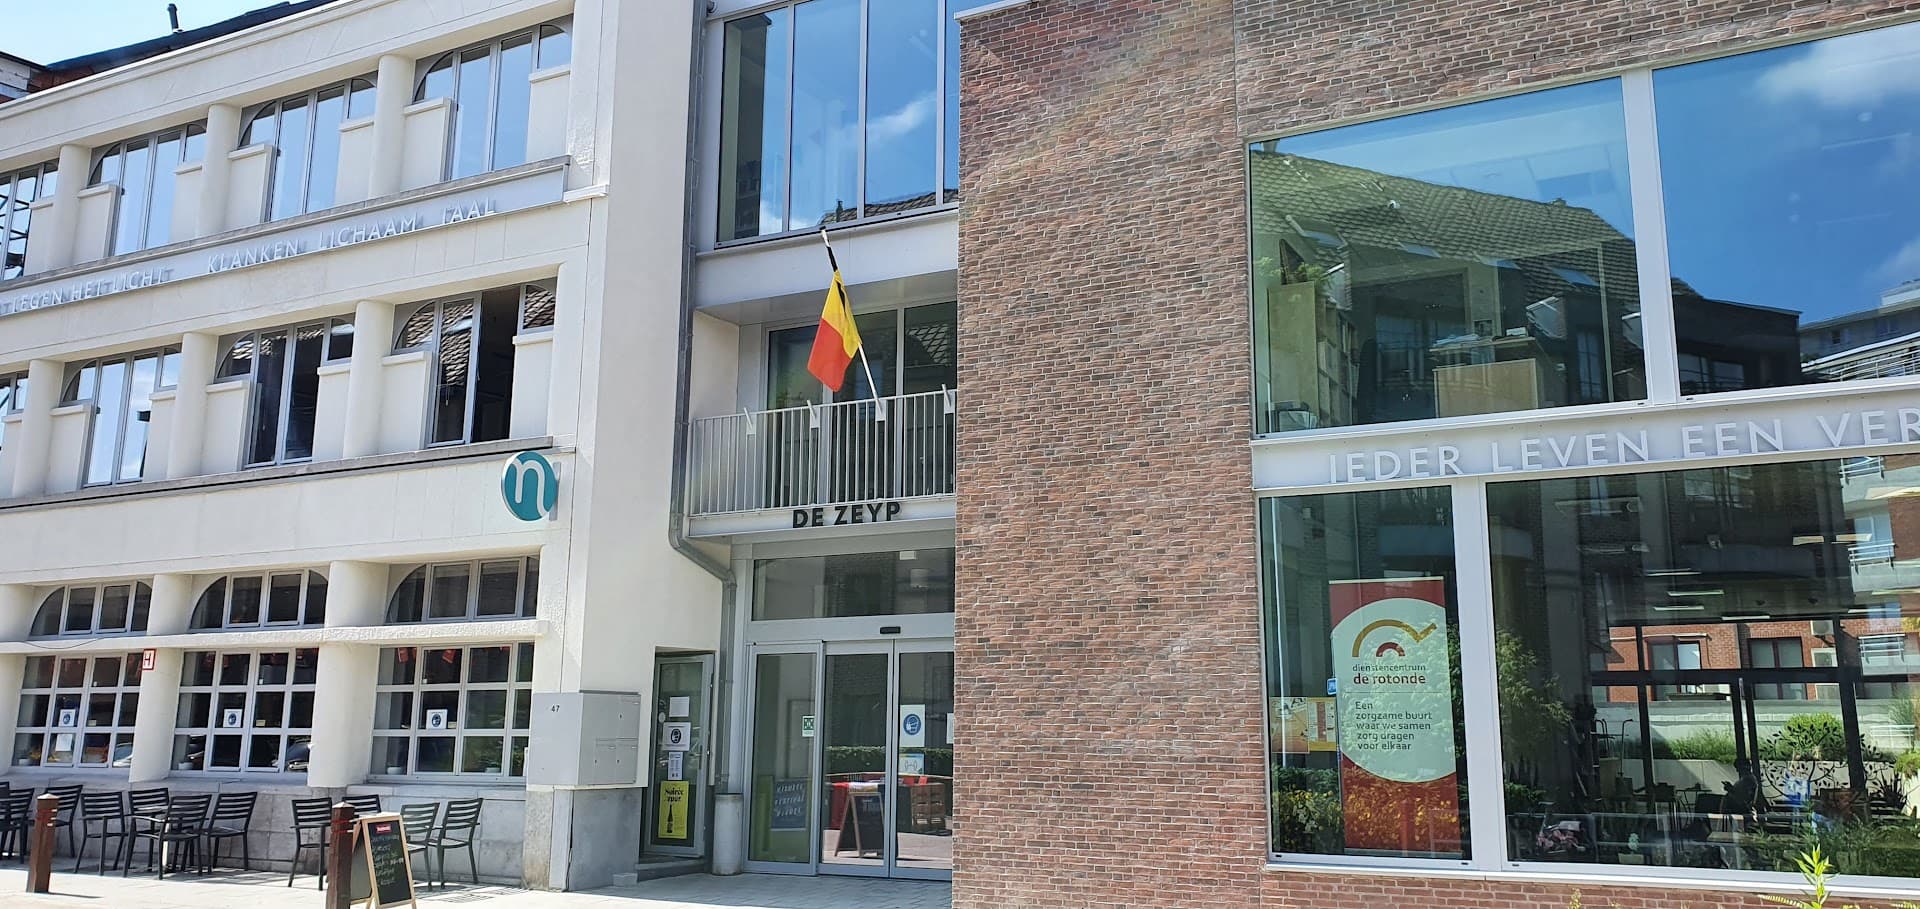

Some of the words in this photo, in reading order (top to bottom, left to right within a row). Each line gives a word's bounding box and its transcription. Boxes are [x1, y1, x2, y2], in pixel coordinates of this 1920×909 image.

[207, 239, 300, 273] KLANKEN
[319, 215, 418, 250] LICHAAM
[1329, 446, 1465, 484] IEDER
[1491, 430, 1650, 473] LEVEN
[1681, 419, 1785, 459] EEN
[793, 507, 824, 528] DE
[833, 501, 901, 525] ZEYP
[1353, 672, 1369, 684] de
[1373, 672, 1426, 684] rotonde
[551, 704, 560, 713] 47
[1355, 701, 1373, 710] Een
[1355, 712, 1403, 721] zorgzame
[1405, 711, 1432, 720] buurt
[1356, 722, 1379, 730] waar
[1382, 722, 1396, 730] we
[1398, 722, 1431, 730] samen
[1357, 733, 1380, 742] zorg
[1380, 732, 1415, 742] dragen
[1381, 741, 1412, 750] elkaar
